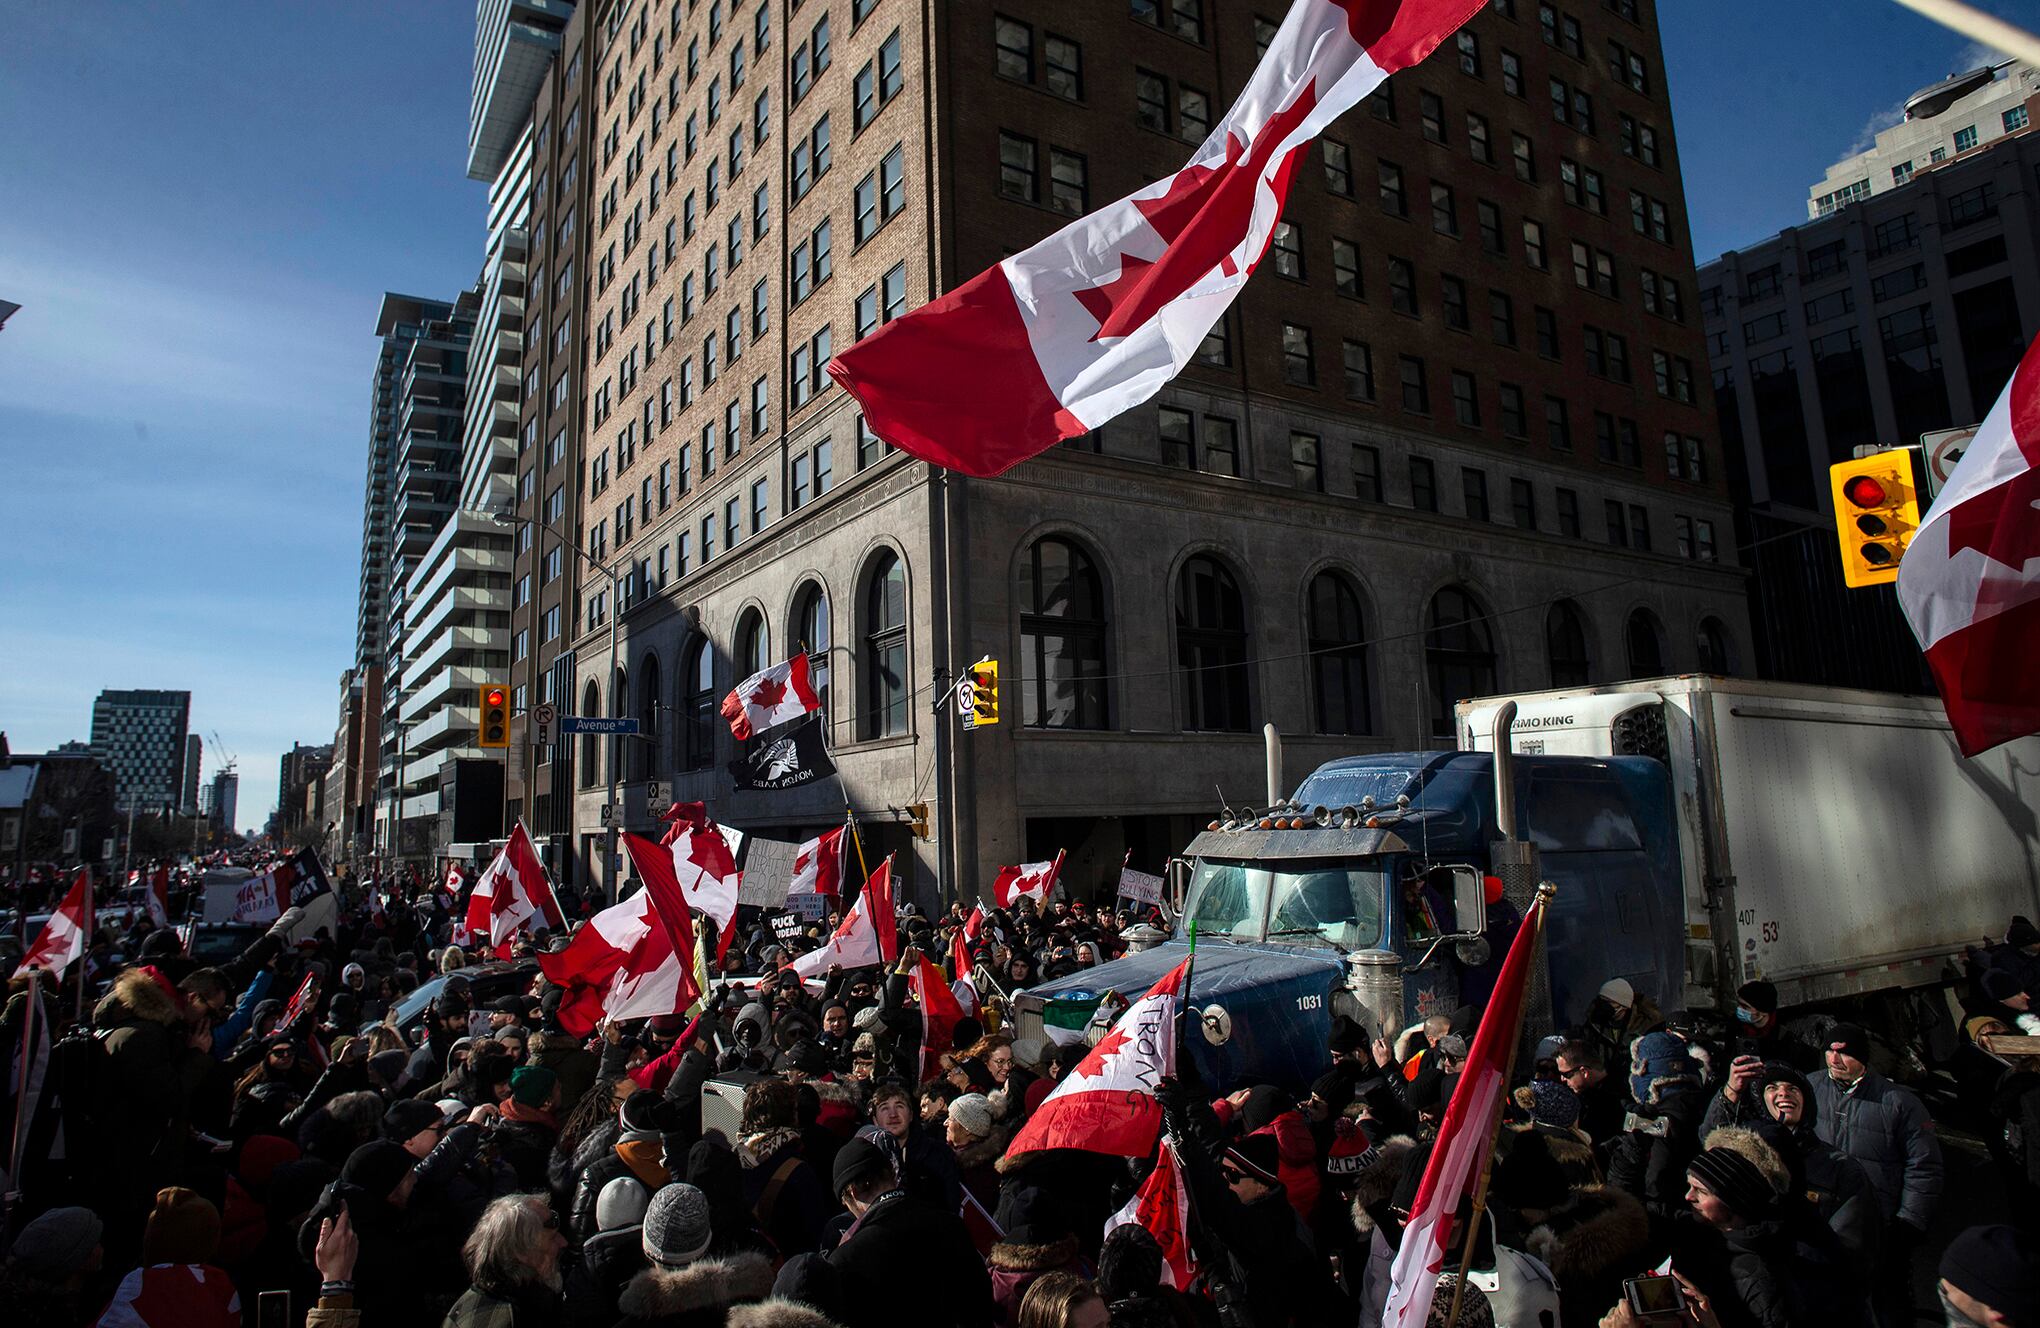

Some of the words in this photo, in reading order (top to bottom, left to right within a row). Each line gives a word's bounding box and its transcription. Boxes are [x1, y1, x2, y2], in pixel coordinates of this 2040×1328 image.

[576, 719, 616, 731] Avenue
[1512, 718, 1540, 728] RMO
[1543, 715, 1574, 726] KING
[1127, 871, 1158, 887] STOP
[1120, 883, 1159, 901] BULLYING
[1738, 909, 1755, 926] 407
[775, 925, 803, 939] UDEAU!
[1296, 994, 1322, 1011] 1031
